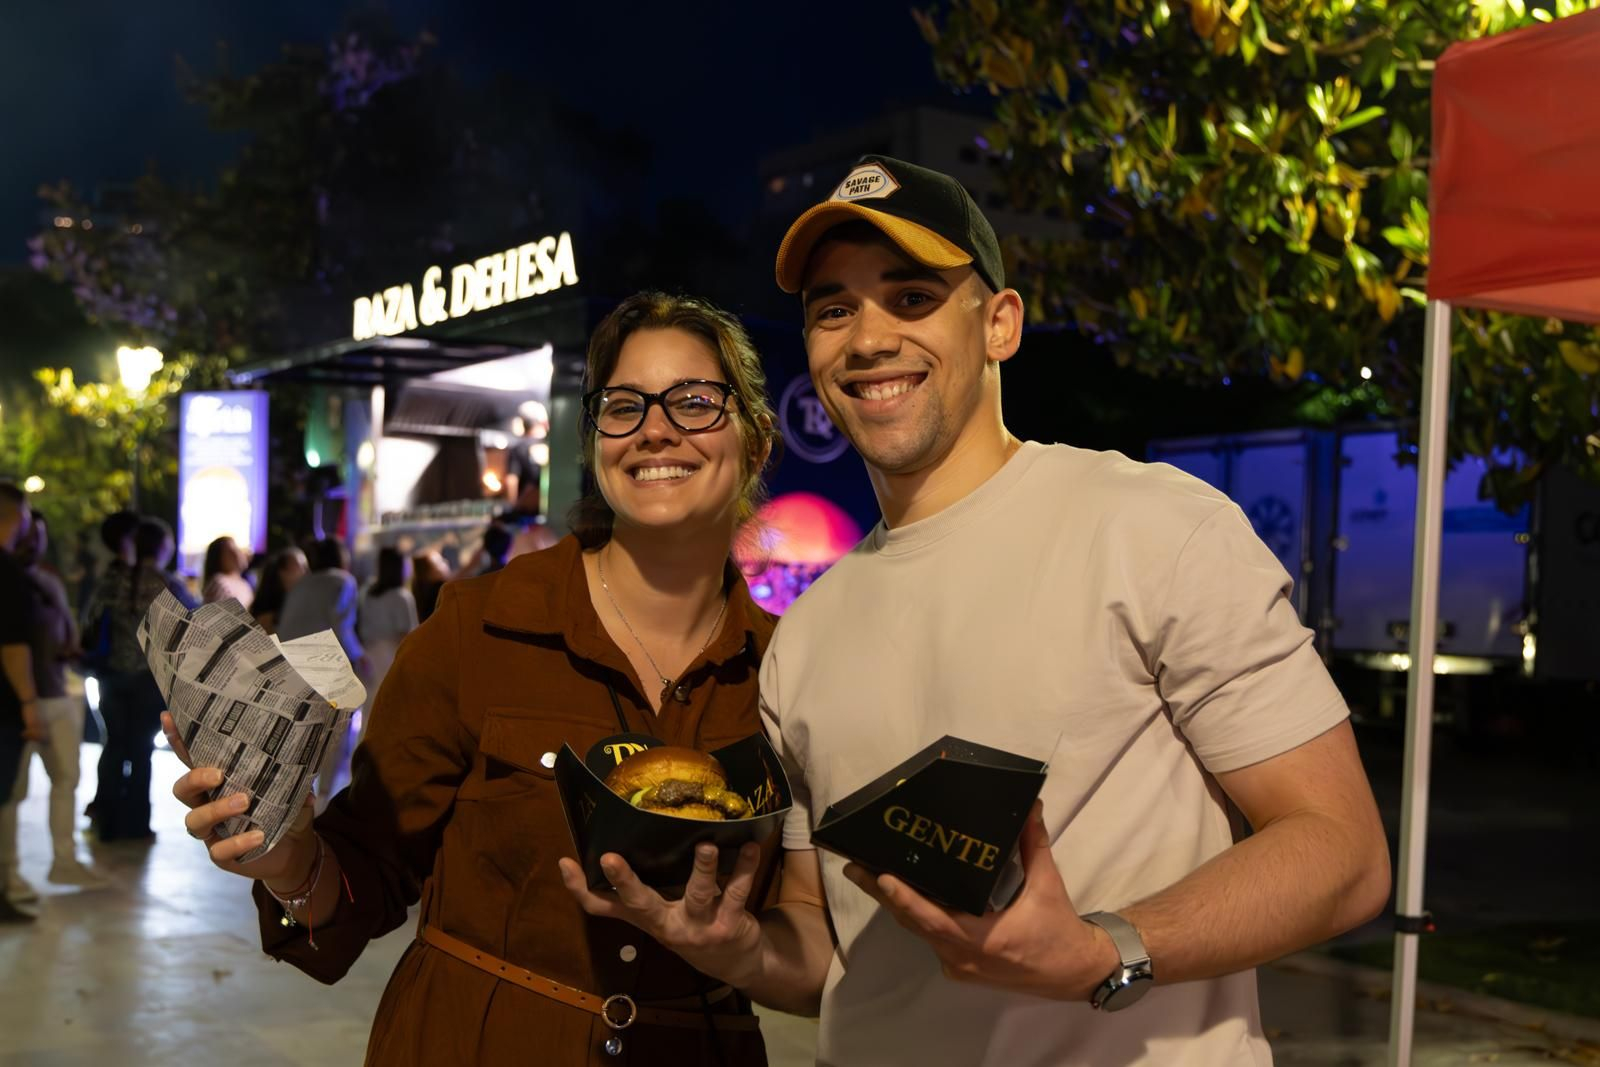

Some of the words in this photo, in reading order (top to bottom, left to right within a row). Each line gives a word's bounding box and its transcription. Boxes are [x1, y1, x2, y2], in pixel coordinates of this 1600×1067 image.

[845, 175, 881, 189] SAVAGE
[848, 184, 871, 195] PATH
[419, 265, 448, 326] &
[450, 231, 579, 318] DEHESA
[883, 805, 1000, 871] GENTE
